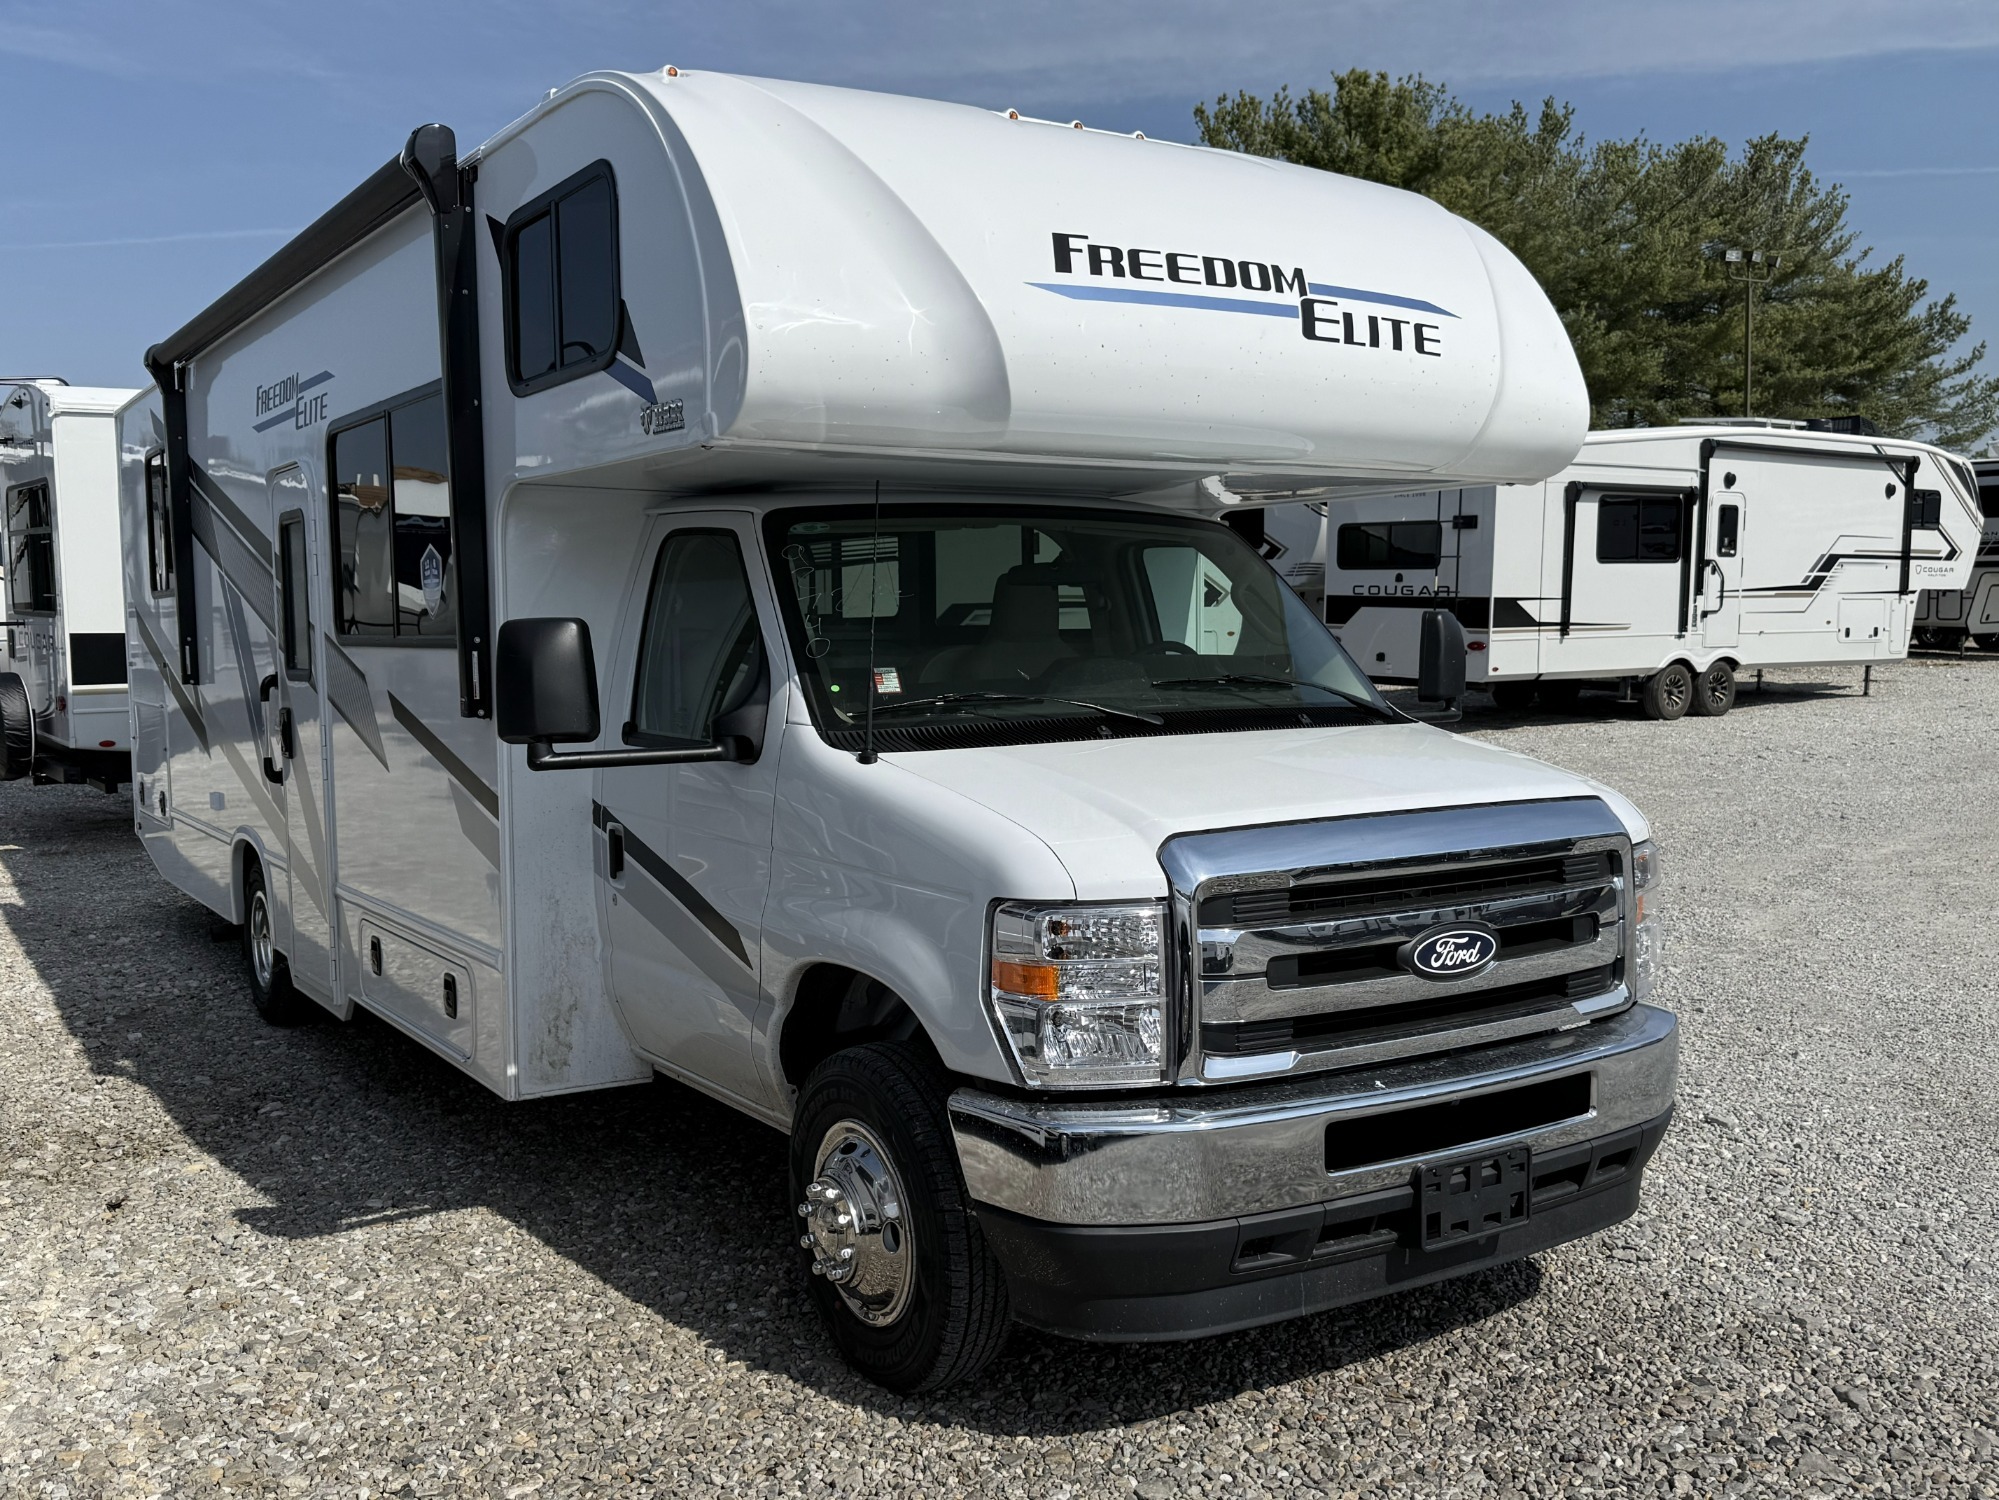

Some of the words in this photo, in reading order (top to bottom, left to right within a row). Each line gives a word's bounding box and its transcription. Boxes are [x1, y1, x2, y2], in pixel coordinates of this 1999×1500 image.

[1052, 232, 1308, 297] FREEDOM
[1300, 298, 1441, 357] ELITE
[256, 372, 299, 417] FREEDOM
[296, 392, 328, 430] ELITE
[1353, 585, 1450, 596] COUGAR
[1431, 937, 1481, 967] Ford
